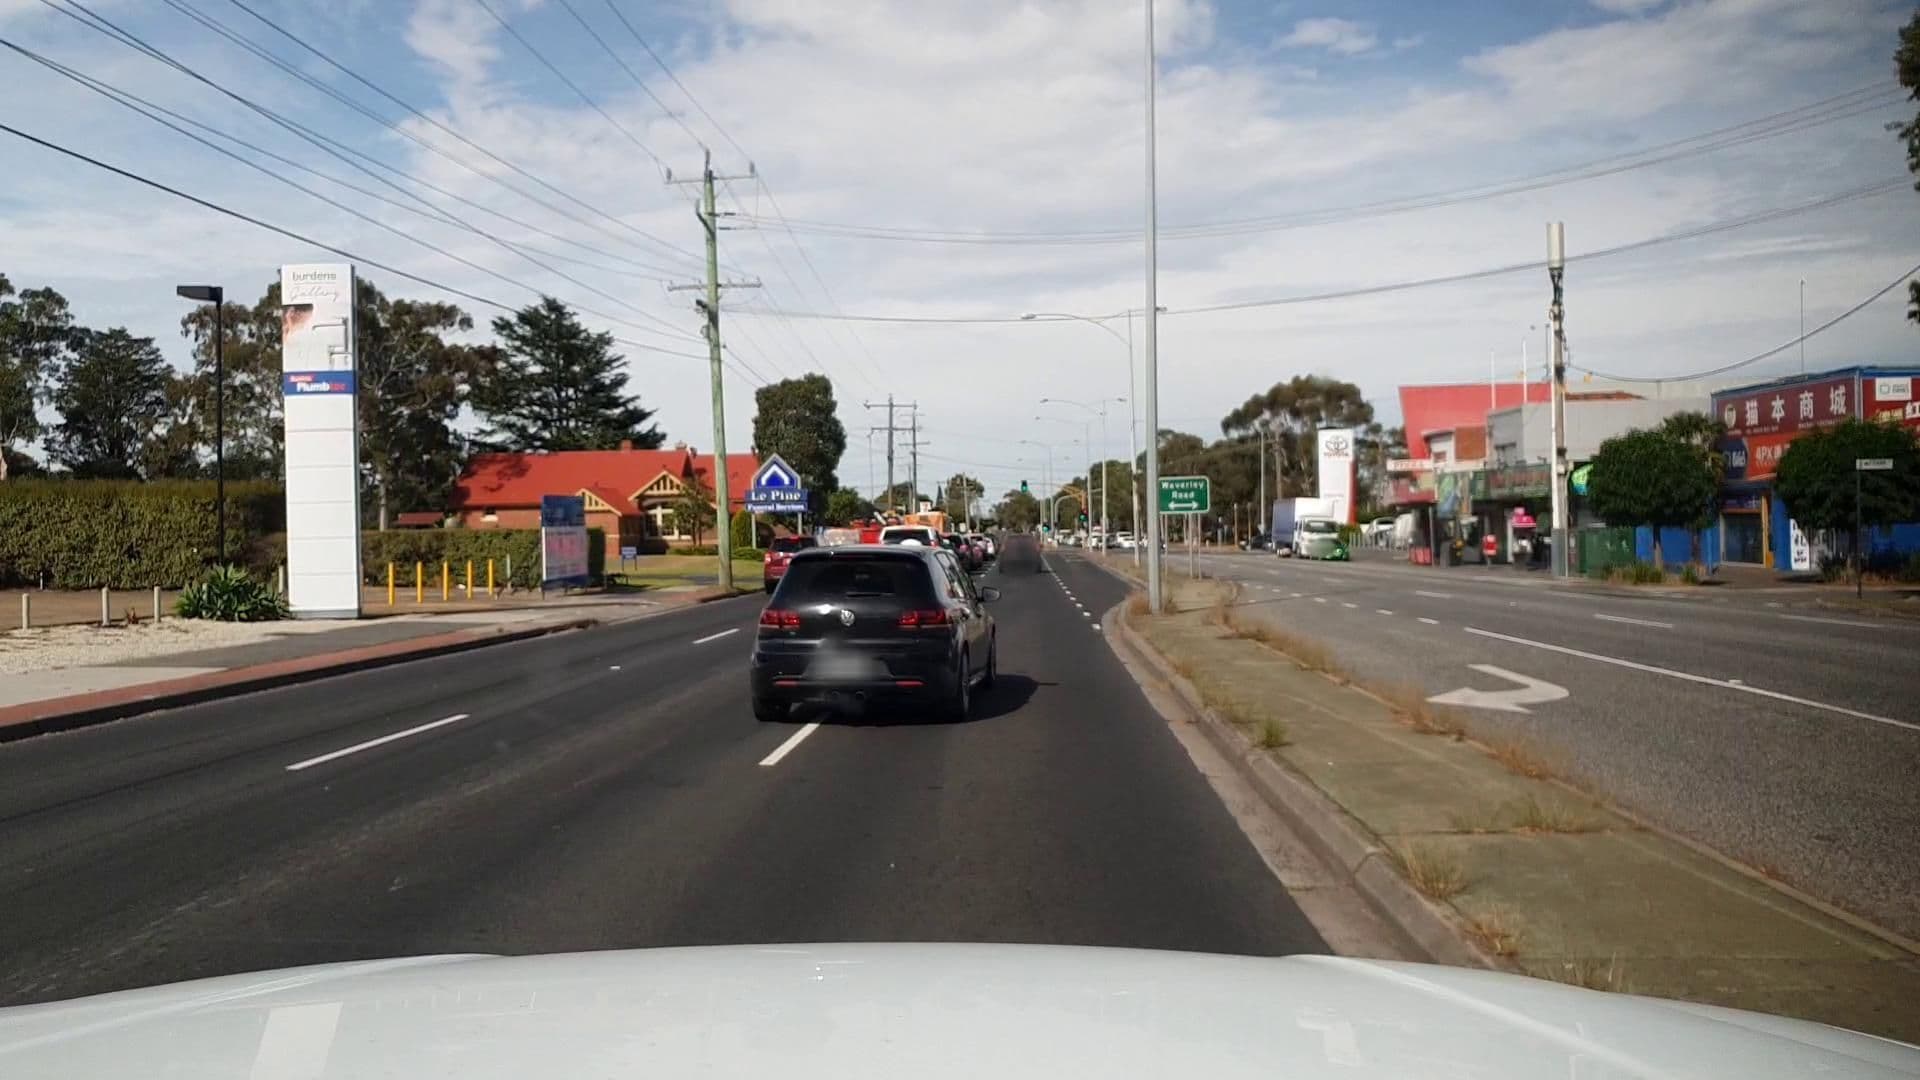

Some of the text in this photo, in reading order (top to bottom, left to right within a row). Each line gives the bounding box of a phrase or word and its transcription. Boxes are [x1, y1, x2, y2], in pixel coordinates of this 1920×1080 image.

[293, 270, 336, 281] burdens
[1161, 480, 1205, 490] Waverley
[751, 490, 801, 501] Le Pine
[1171, 490, 1195, 500] Road
